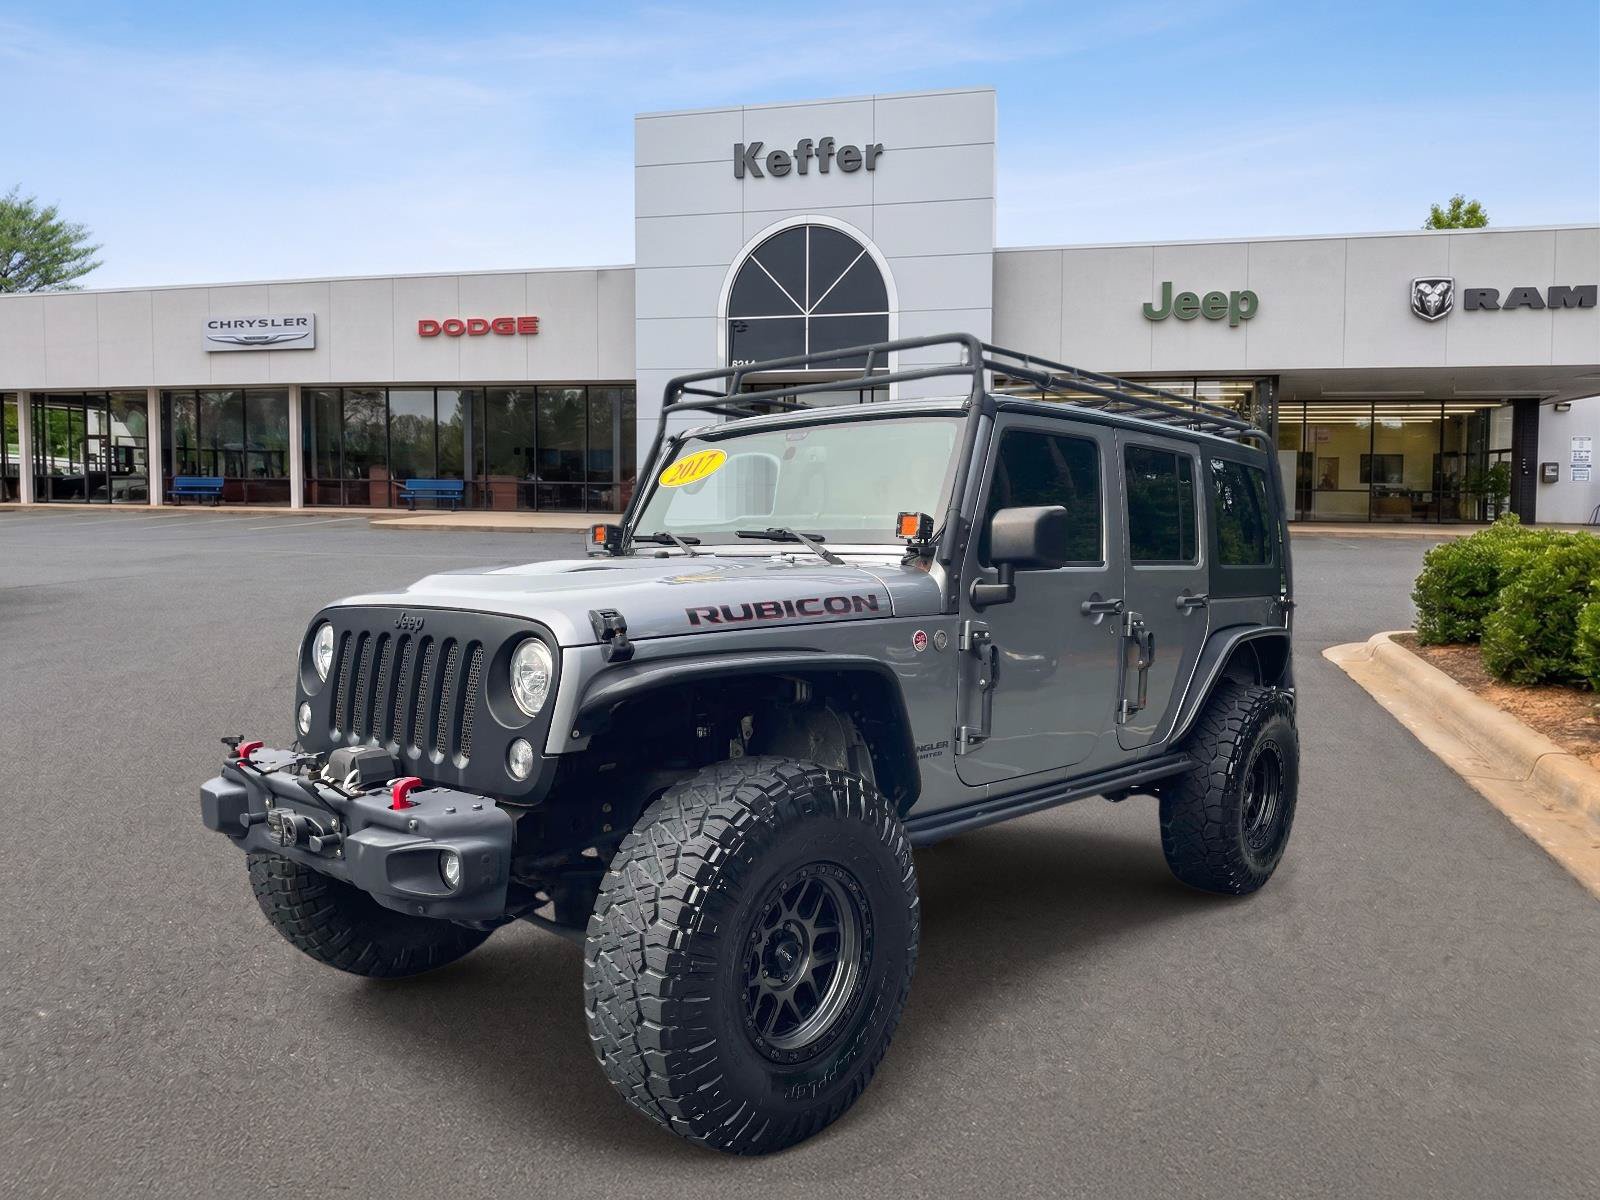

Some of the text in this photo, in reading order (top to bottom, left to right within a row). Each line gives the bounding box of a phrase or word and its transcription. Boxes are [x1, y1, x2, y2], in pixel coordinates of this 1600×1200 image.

[733, 136, 884, 179] Keffer
[1142, 281, 1259, 328] Jeep
[1463, 285, 1598, 311] RAM
[207, 317, 308, 330] CHRYSLER
[418, 316, 540, 337] DODGE
[667, 452, 720, 484] 2017
[394, 611, 425, 634] Jeep
[685, 594, 880, 626] RUBICON
[916, 740, 949, 753] NGLER
